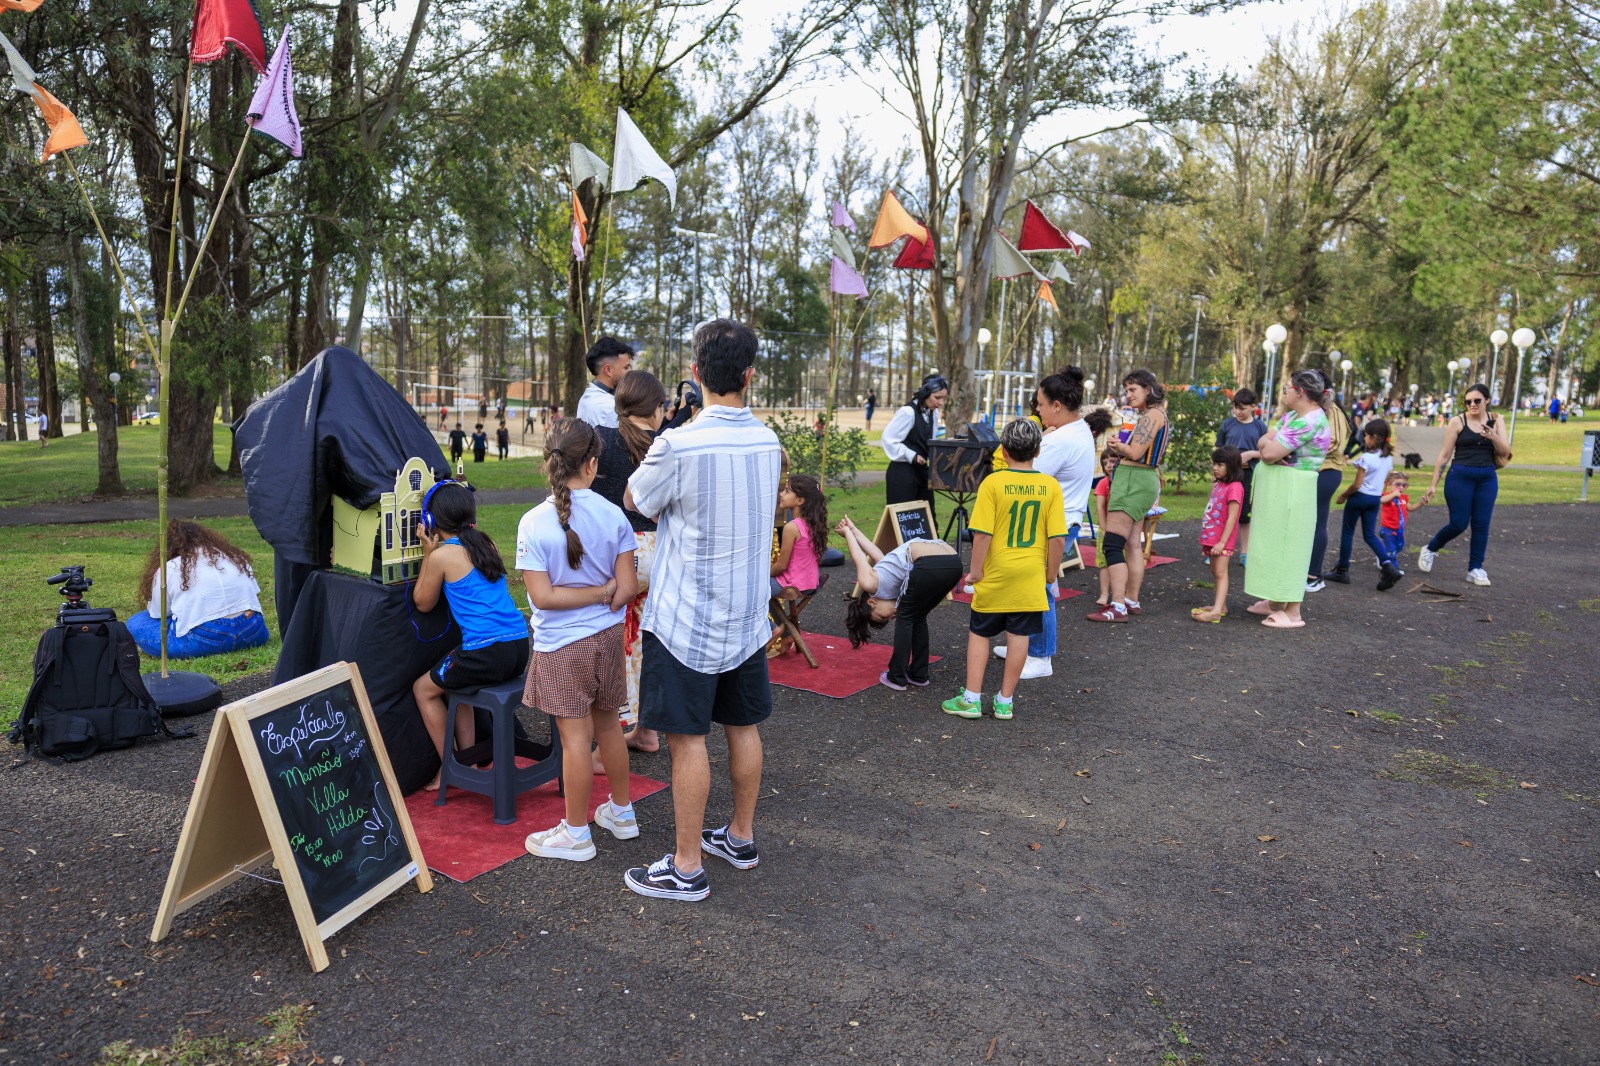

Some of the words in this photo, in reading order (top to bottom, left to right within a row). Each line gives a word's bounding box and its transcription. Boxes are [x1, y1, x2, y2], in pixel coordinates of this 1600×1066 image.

[1004, 484, 1035, 495] NEYMAR
[1038, 485, 1047, 496] JR
[1007, 500, 1041, 548] 10
[261, 700, 346, 758] Espetáculo
[279, 748, 342, 788] Mansão
[306, 781, 349, 815] Villa
[326, 805, 368, 838] Hilda
[305, 837, 323, 857] 15:00
[322, 849, 343, 868] 18:00
